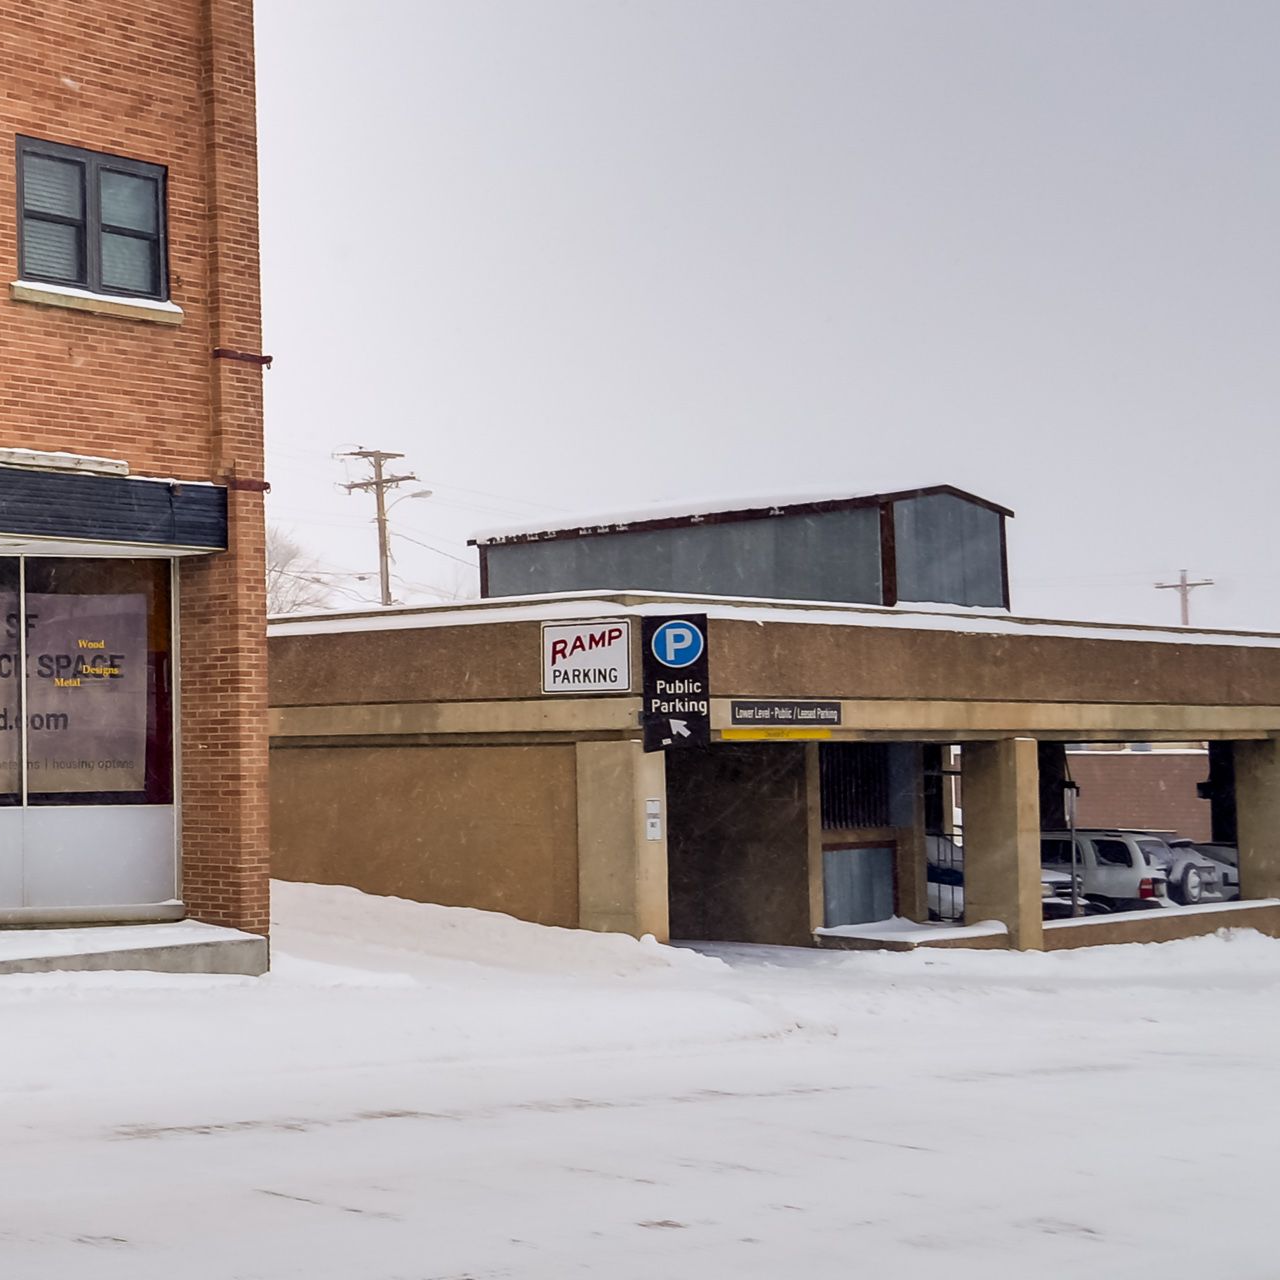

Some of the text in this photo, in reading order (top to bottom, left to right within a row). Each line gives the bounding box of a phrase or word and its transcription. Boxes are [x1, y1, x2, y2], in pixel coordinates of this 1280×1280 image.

[78, 639, 106, 649] Wood
[551, 627, 623, 667] RAMP
[37, 654, 126, 680] SPACE
[82, 664, 120, 676] Designs
[54, 677, 82, 688] Metal
[552, 667, 618, 685] PARKING
[656, 679, 702, 695] Public
[651, 698, 708, 716] Parking
[735, 706, 754, 719] Lower
[754, 706, 771, 719] Level
[774, 707, 793, 719] Public
[816, 707, 838, 722] Parking
[52, 758, 94, 772] housing
